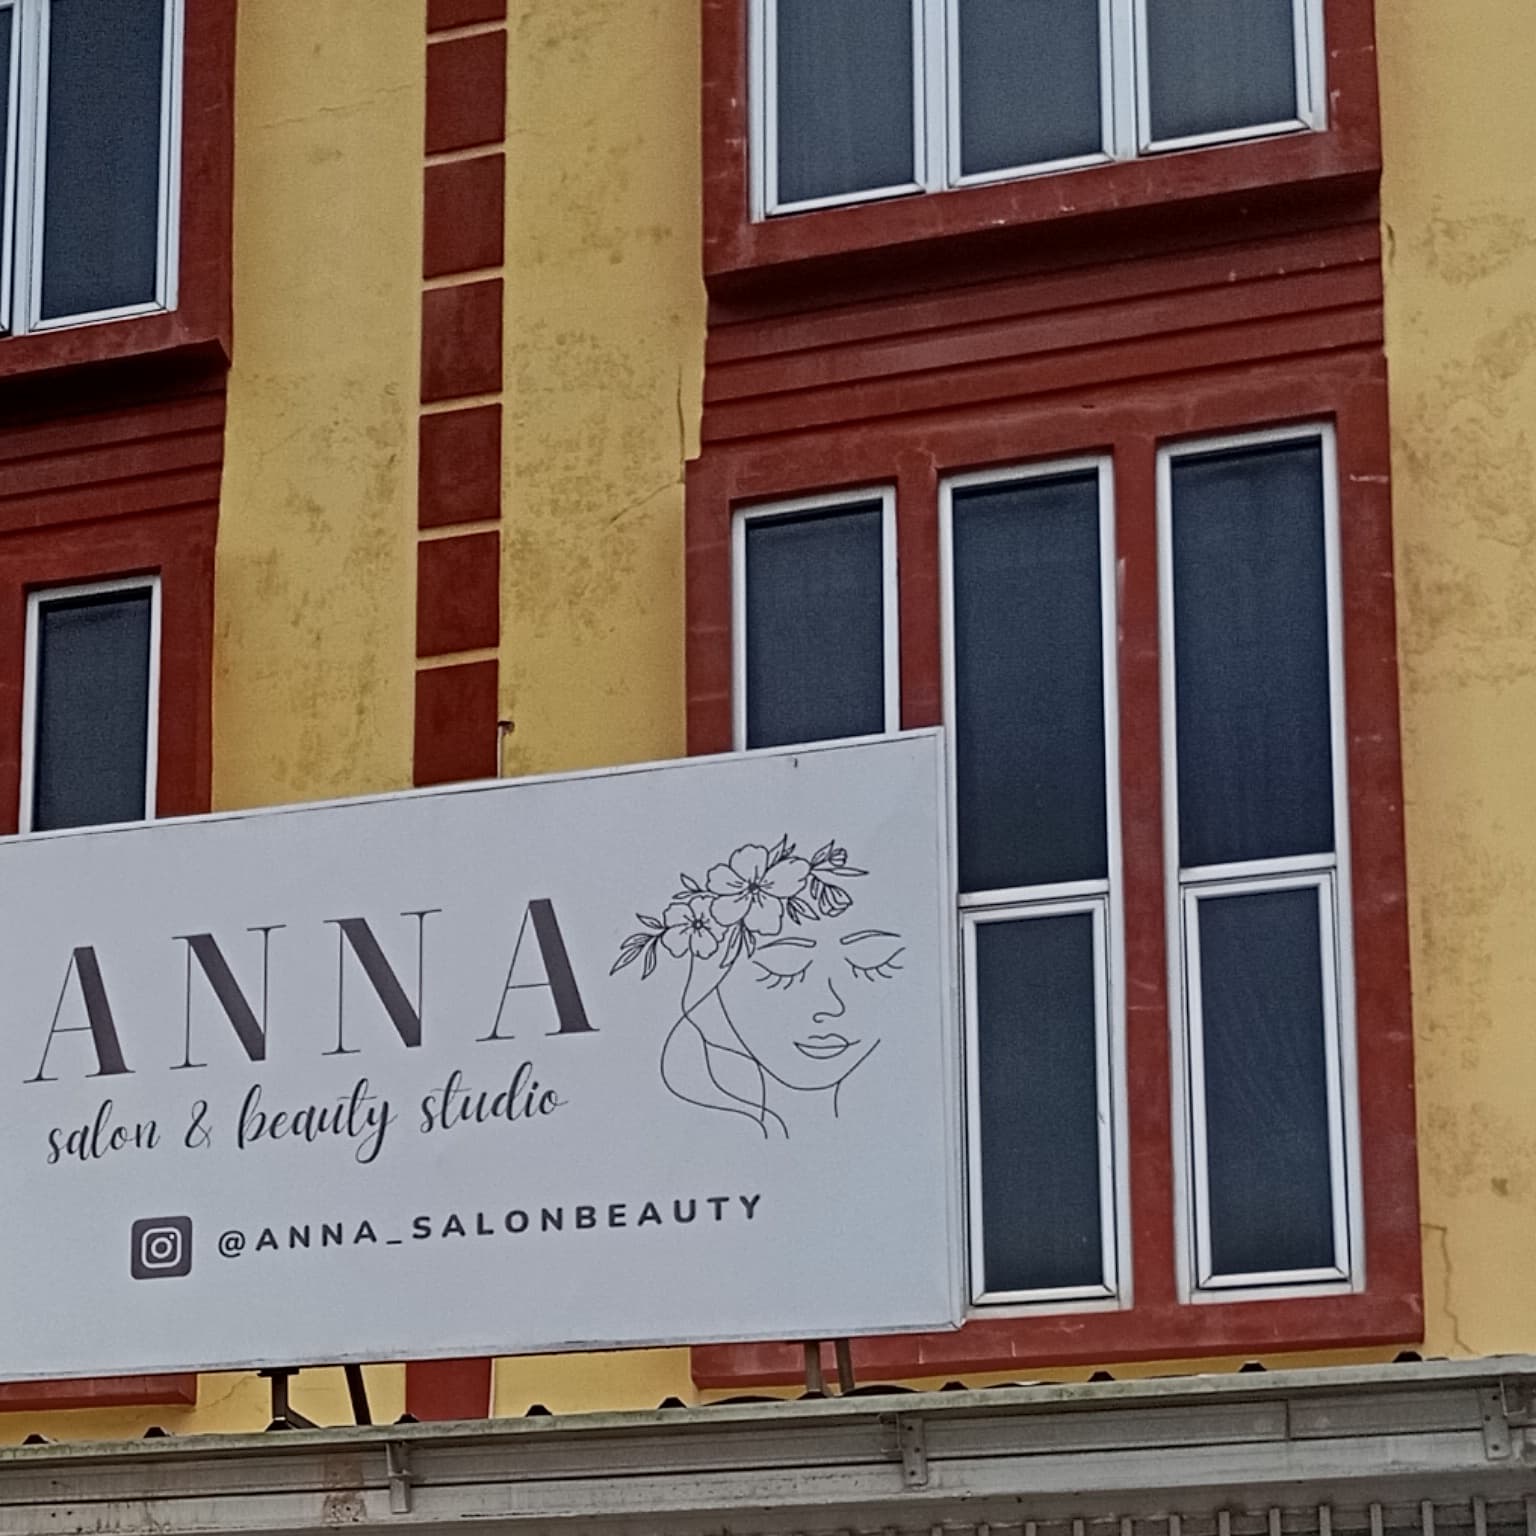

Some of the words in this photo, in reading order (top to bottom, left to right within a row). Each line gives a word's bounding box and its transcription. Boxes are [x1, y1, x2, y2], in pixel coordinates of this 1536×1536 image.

[23, 897, 599, 1083] ANNA
[46, 1100, 161, 1164] salon
[184, 1100, 212, 1149] &
[237, 1077, 398, 1164] beauty
[420, 1061, 568, 1134] studio
[218, 1194, 762, 1259] @ANNA_SALONBEAUTY
